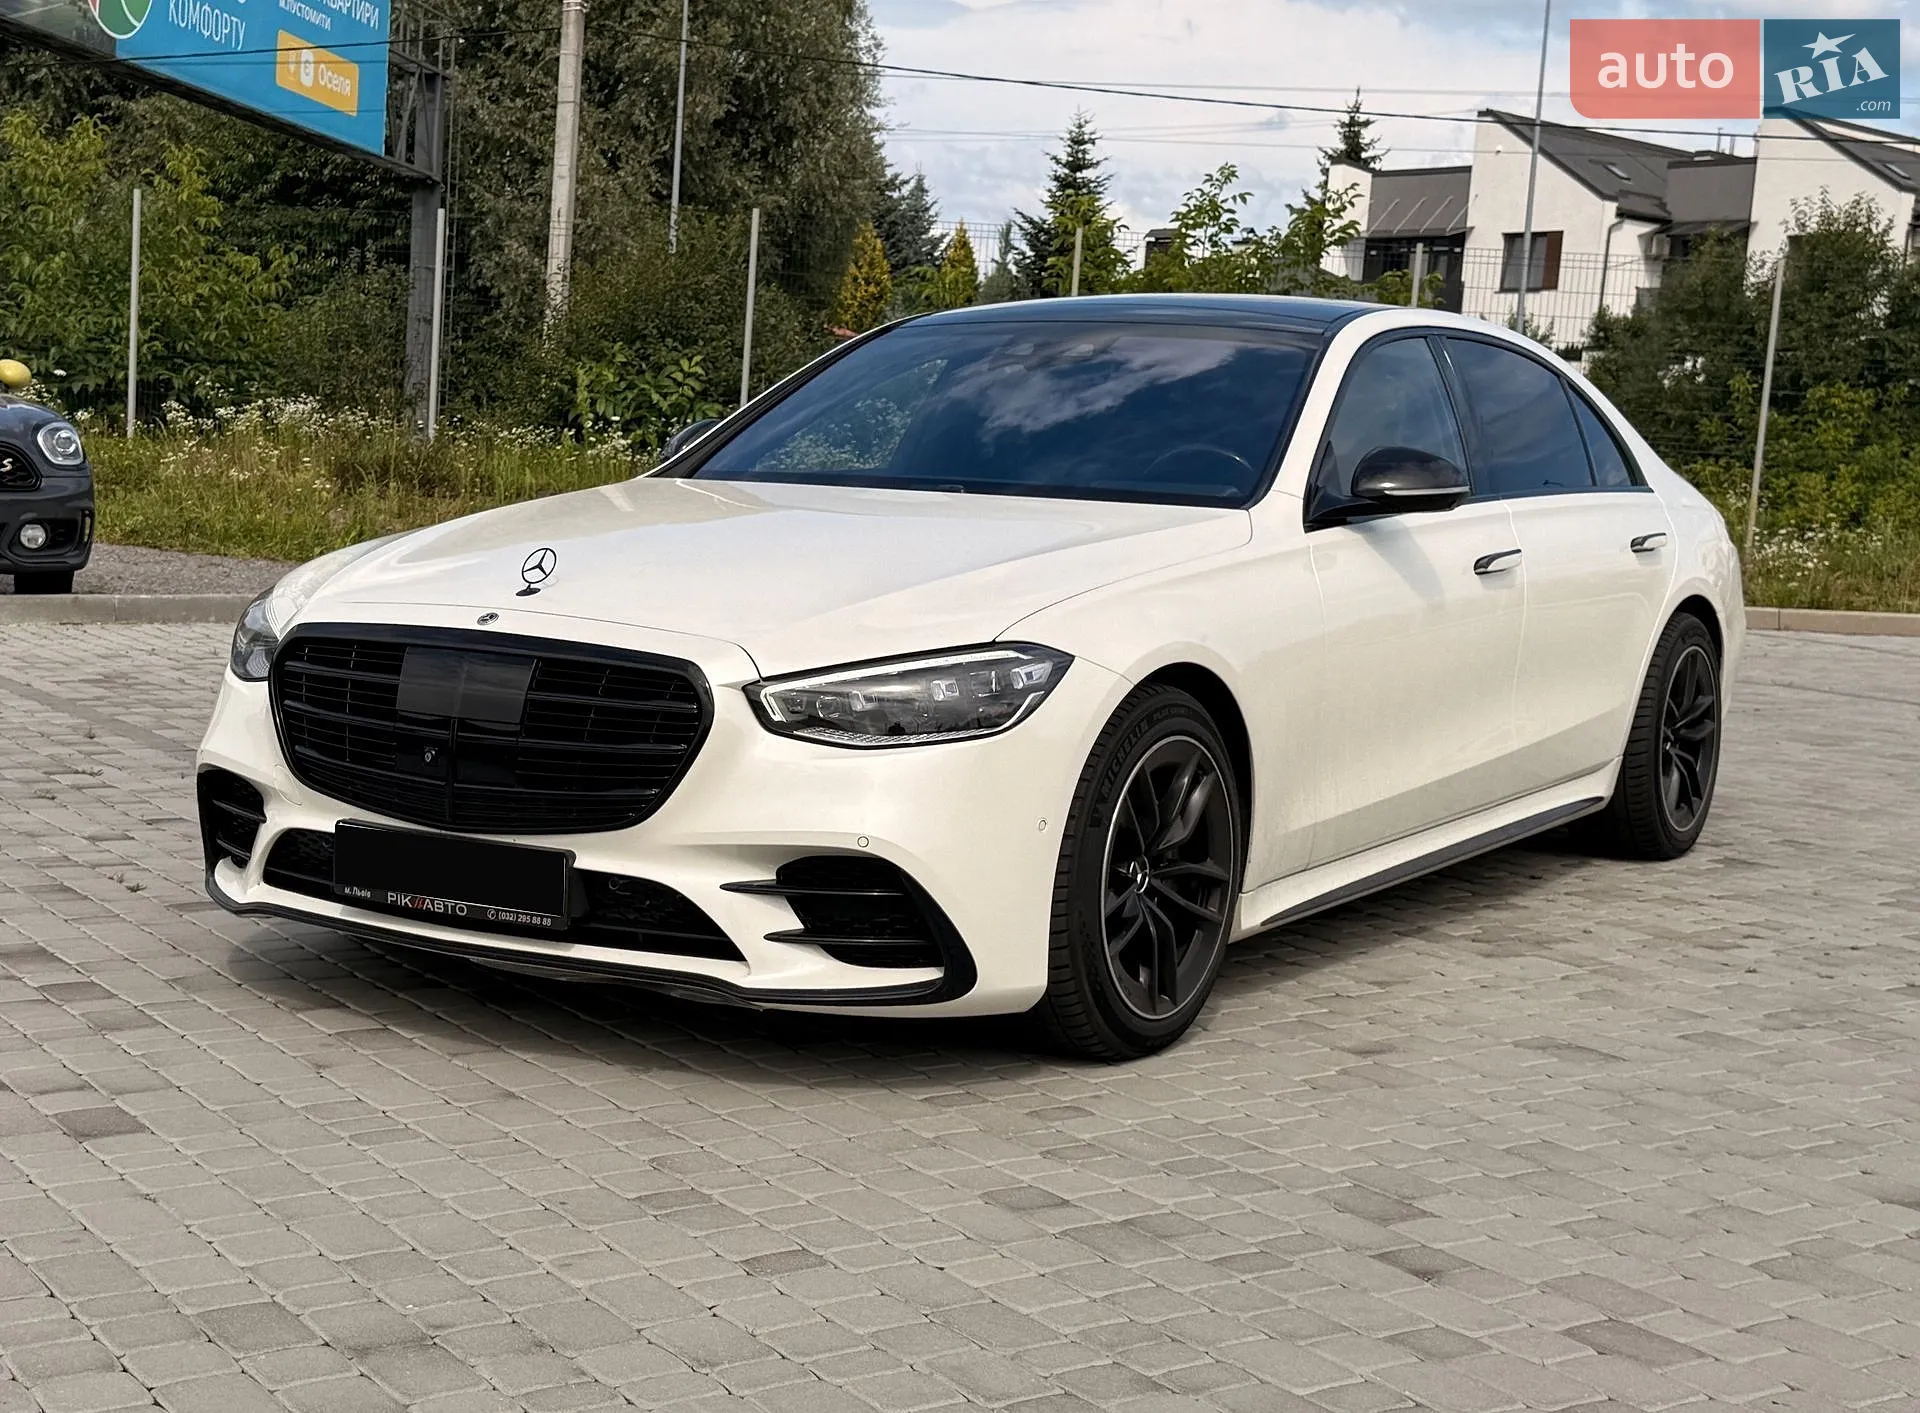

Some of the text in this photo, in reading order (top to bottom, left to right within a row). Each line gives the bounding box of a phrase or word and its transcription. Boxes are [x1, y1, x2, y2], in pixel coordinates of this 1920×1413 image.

[168, 0, 246, 50] КОМФОРТУ
[323, 0, 379, 31] АРТИРИ
[318, 63, 351, 97] Оселя
[1100, 717, 1150, 798] MICHELIN
[498, 911, 552, 926] (032) 295 88 88
